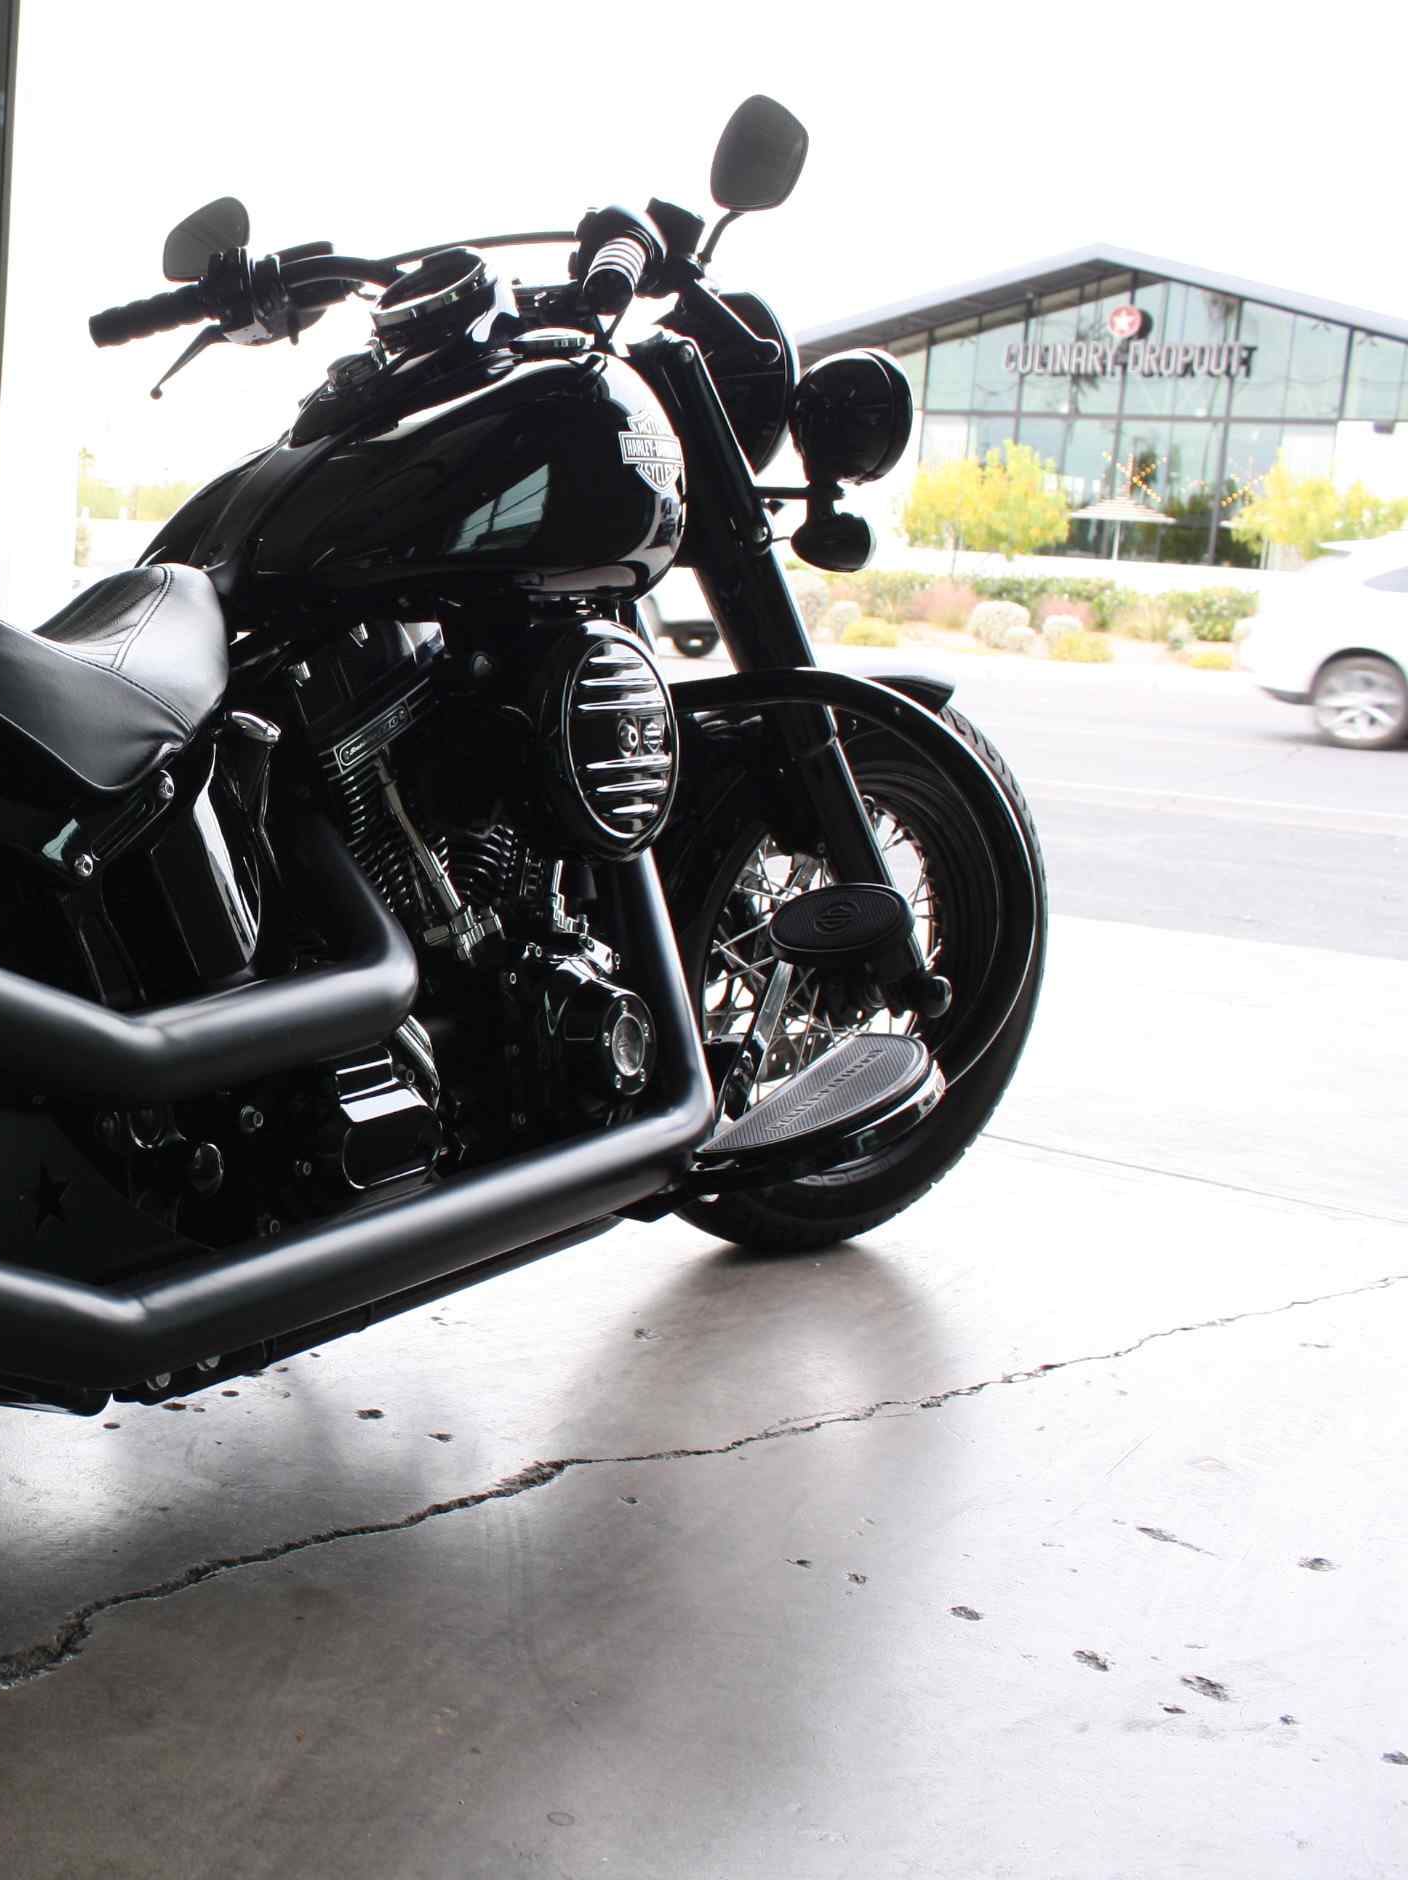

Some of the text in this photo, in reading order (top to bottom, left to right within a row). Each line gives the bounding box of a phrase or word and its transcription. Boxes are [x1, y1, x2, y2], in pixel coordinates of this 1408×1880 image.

[1002, 340, 1257, 377] CULINARY DROPOUT
[625, 438, 680, 459] HARLEY-DA
